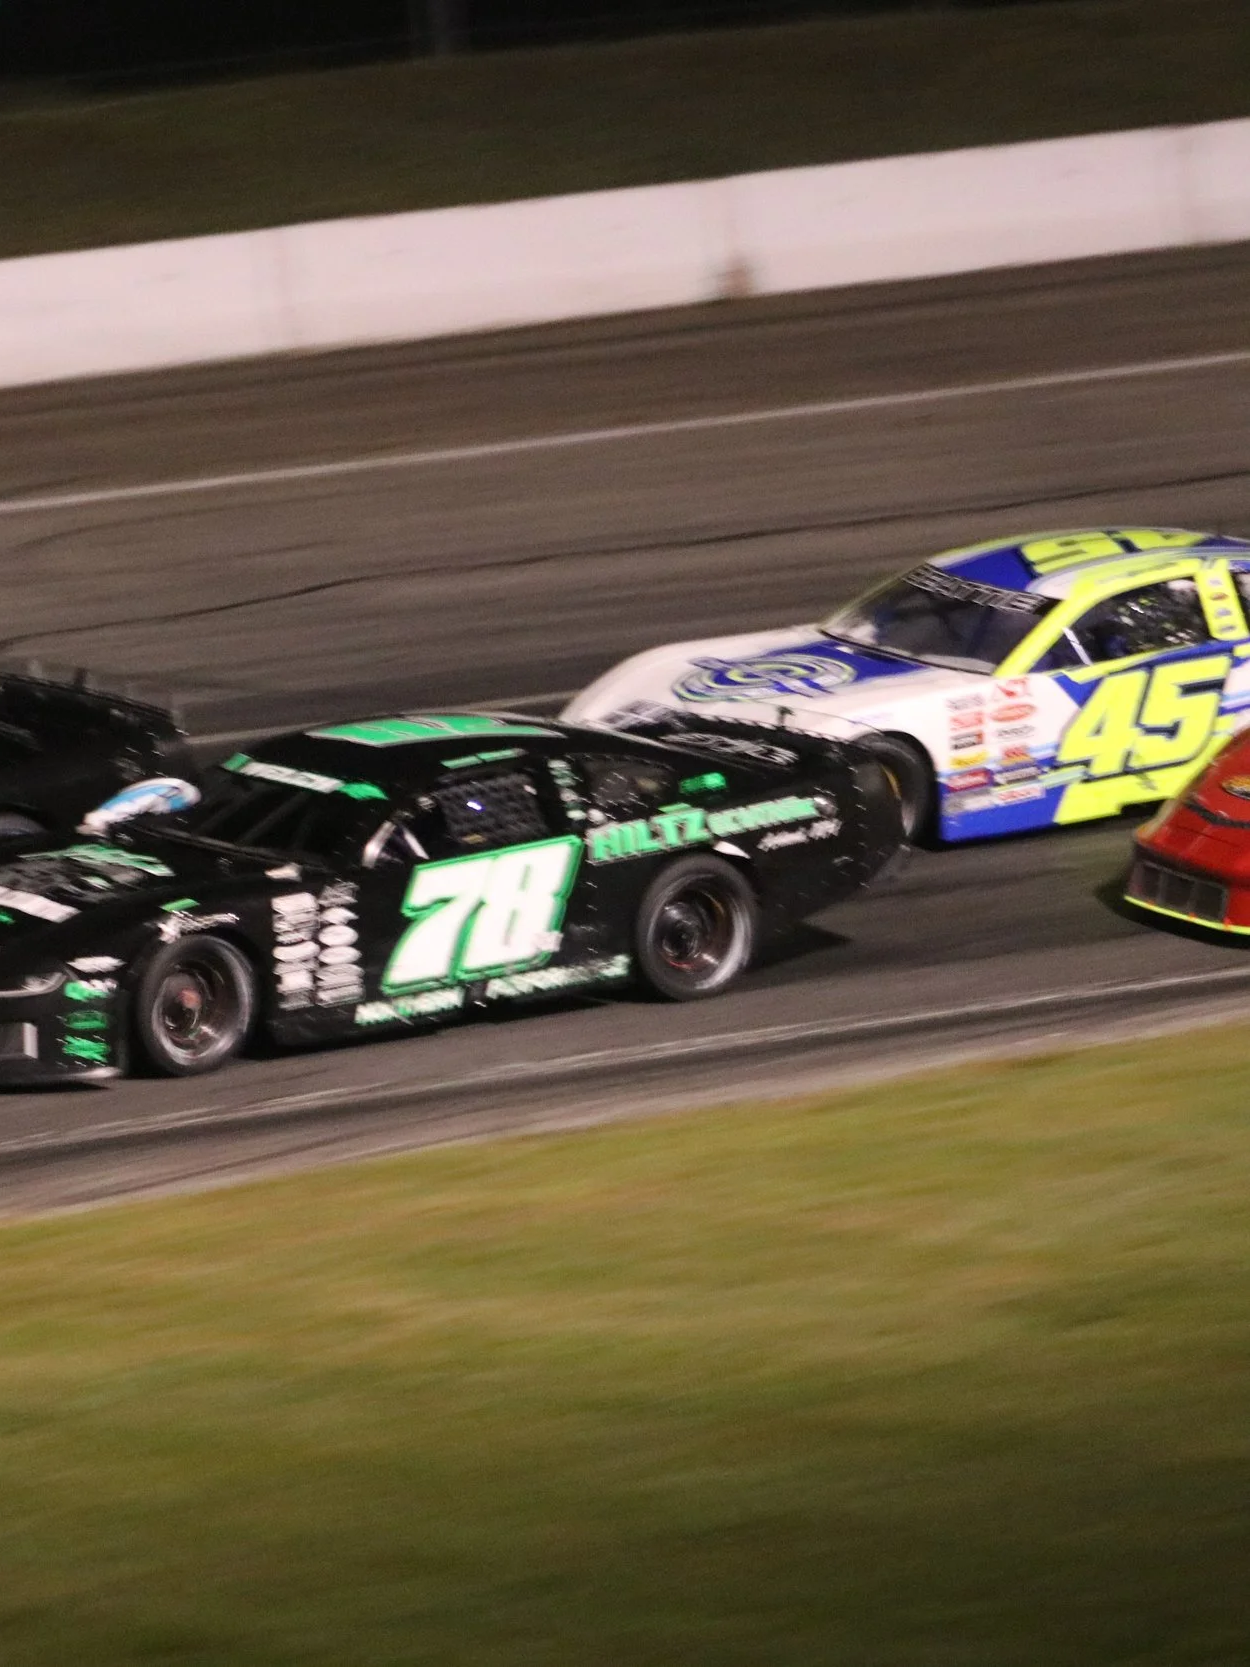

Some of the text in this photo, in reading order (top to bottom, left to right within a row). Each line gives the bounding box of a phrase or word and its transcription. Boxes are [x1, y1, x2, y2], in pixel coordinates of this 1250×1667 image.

[1054, 654, 1233, 780] 45
[584, 807, 715, 867] HILTZ
[381, 834, 585, 996] 78
